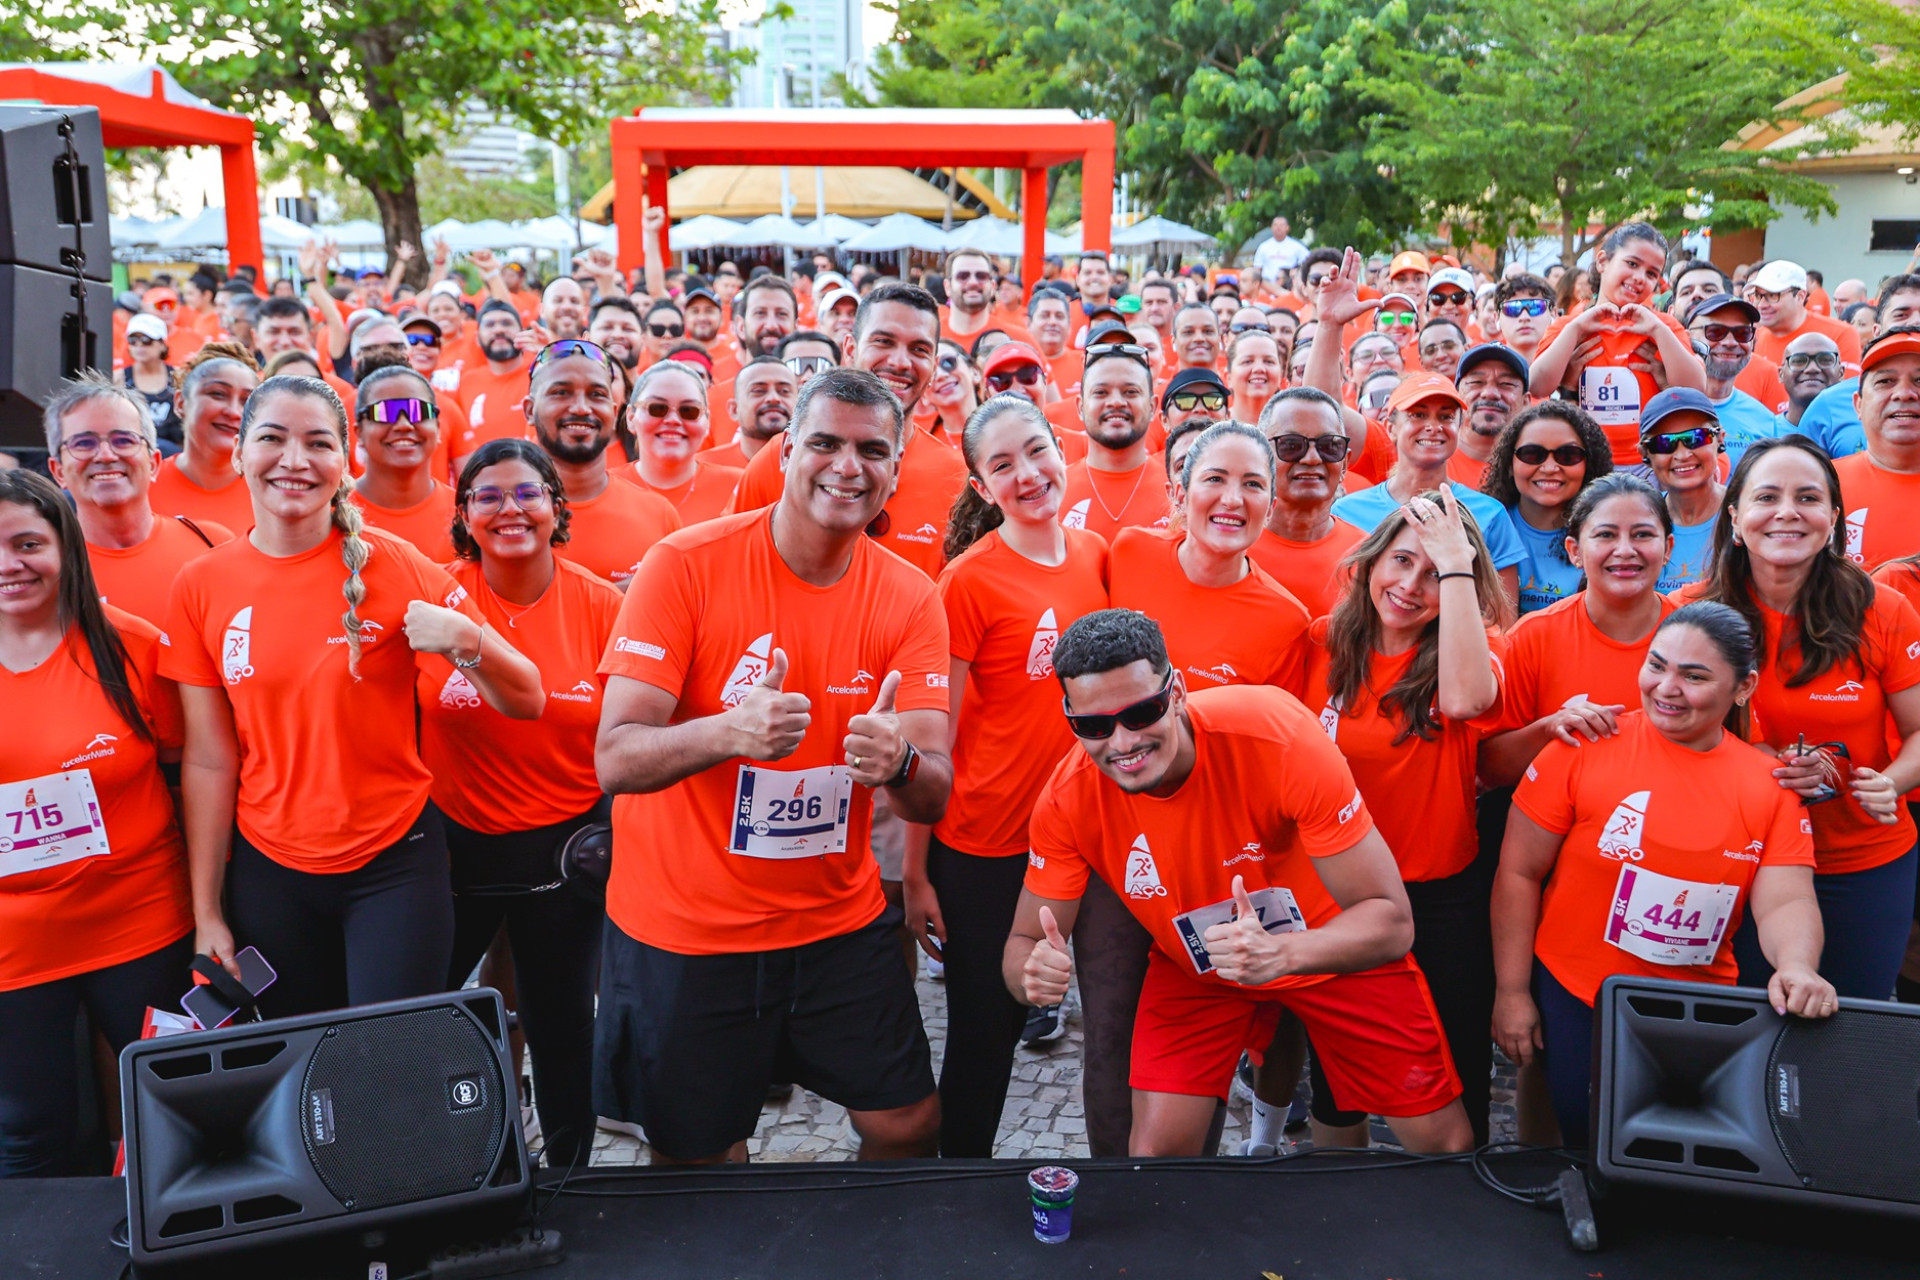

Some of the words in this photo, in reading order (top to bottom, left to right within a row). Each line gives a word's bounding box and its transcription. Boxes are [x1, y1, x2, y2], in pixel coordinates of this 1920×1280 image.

[1598, 386, 1619, 401] 81
[441, 692, 481, 709] AÇO
[740, 794, 752, 827] 2,5K
[767, 795, 822, 822] 296
[5, 803, 64, 834] 715
[36, 832, 67, 846] WANNA
[1600, 840, 1645, 861] AÇO
[1130, 883, 1168, 897] AÇO
[1614, 897, 1628, 917] 5K
[1643, 903, 1702, 932] 444
[460, 1084, 472, 1103] RCF
[1780, 1095, 1788, 1112] ART
[316, 1122, 324, 1141] ART
